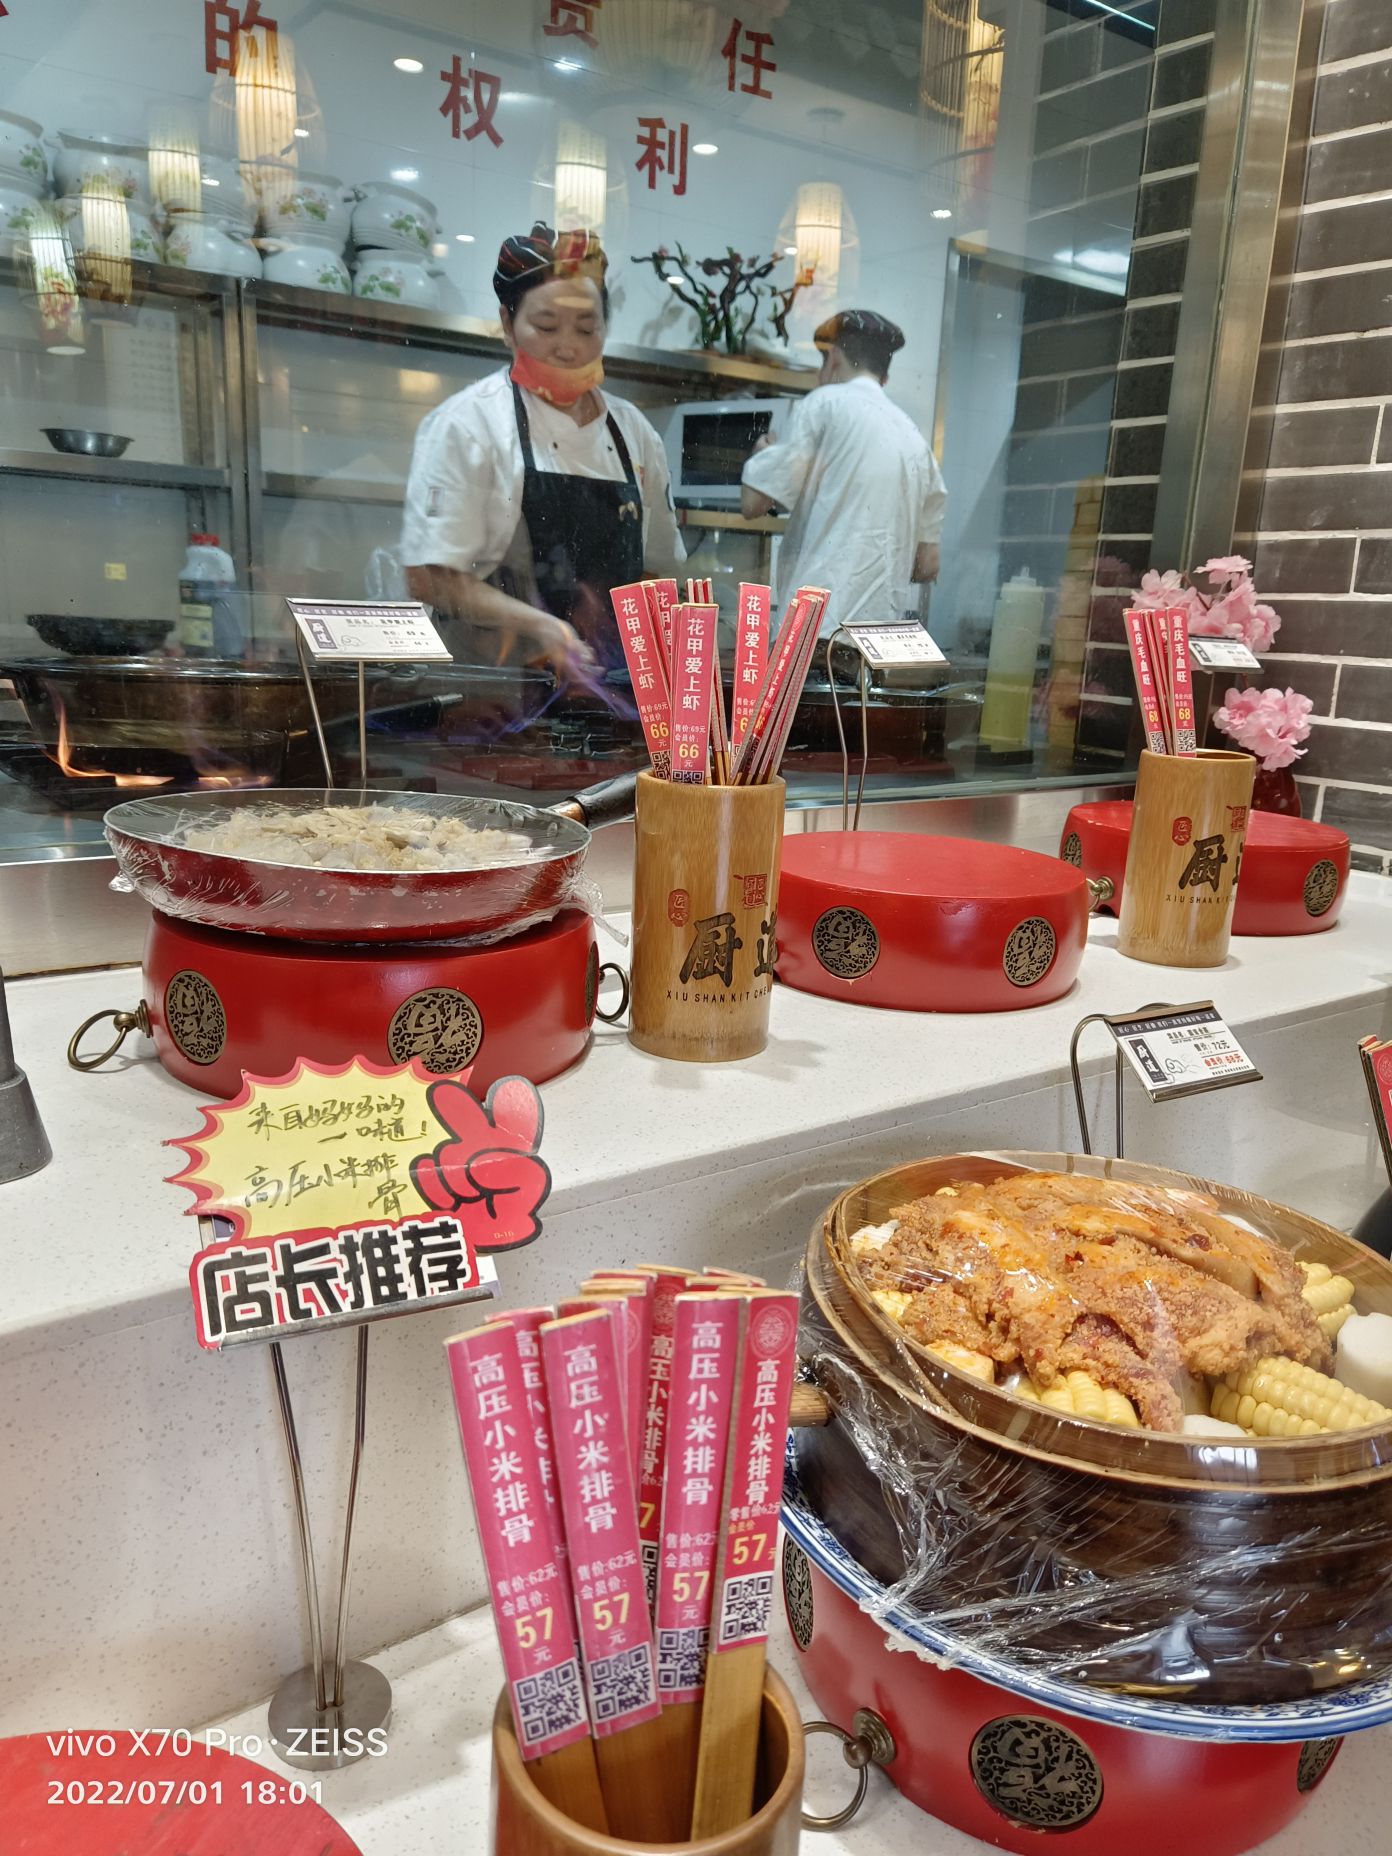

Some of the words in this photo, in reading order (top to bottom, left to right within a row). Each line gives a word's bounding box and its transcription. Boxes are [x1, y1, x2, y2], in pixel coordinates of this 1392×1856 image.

[620, 598, 655, 689] 花甲爱上虾
[743, 595, 762, 684] 花甲爱上虾
[1132, 619, 1151, 685] 重庆毛血旺
[1173, 615, 1187, 683] 重庆毛血旺
[682, 618, 705, 711] 花甲爱上虾
[650, 722, 669, 739] 66
[675, 725, 706, 733] 售价:69元
[1149, 710, 1158, 722] 68
[1179, 708, 1191, 720] 68
[679, 743, 700, 759] 66
[684, 759, 693, 768] 元
[666, 989, 688, 1002] XIU
[694, 993, 725, 1003] SHAN
[367, 1178, 408, 1219] 骨
[204, 1219, 470, 1337] 店长推荐
[682, 1320, 723, 1506] 高压小米排骨
[469, 1352, 535, 1548] 高压小米排骨
[564, 1344, 618, 1533] 高压小米排骨
[745, 1358, 781, 1506] 高压小米排骨
[577, 1550, 637, 1582] 售价:62元
[732, 1533, 768, 1565] 57
[497, 1562, 559, 1598] 售价:62元
[673, 1570, 710, 1603] 57
[515, 1606, 554, 1649] 57
[592, 1592, 630, 1632] 57
[682, 1604, 699, 1620] 元
[534, 1646, 552, 1665] 元
[608, 1629, 626, 1648] 元
